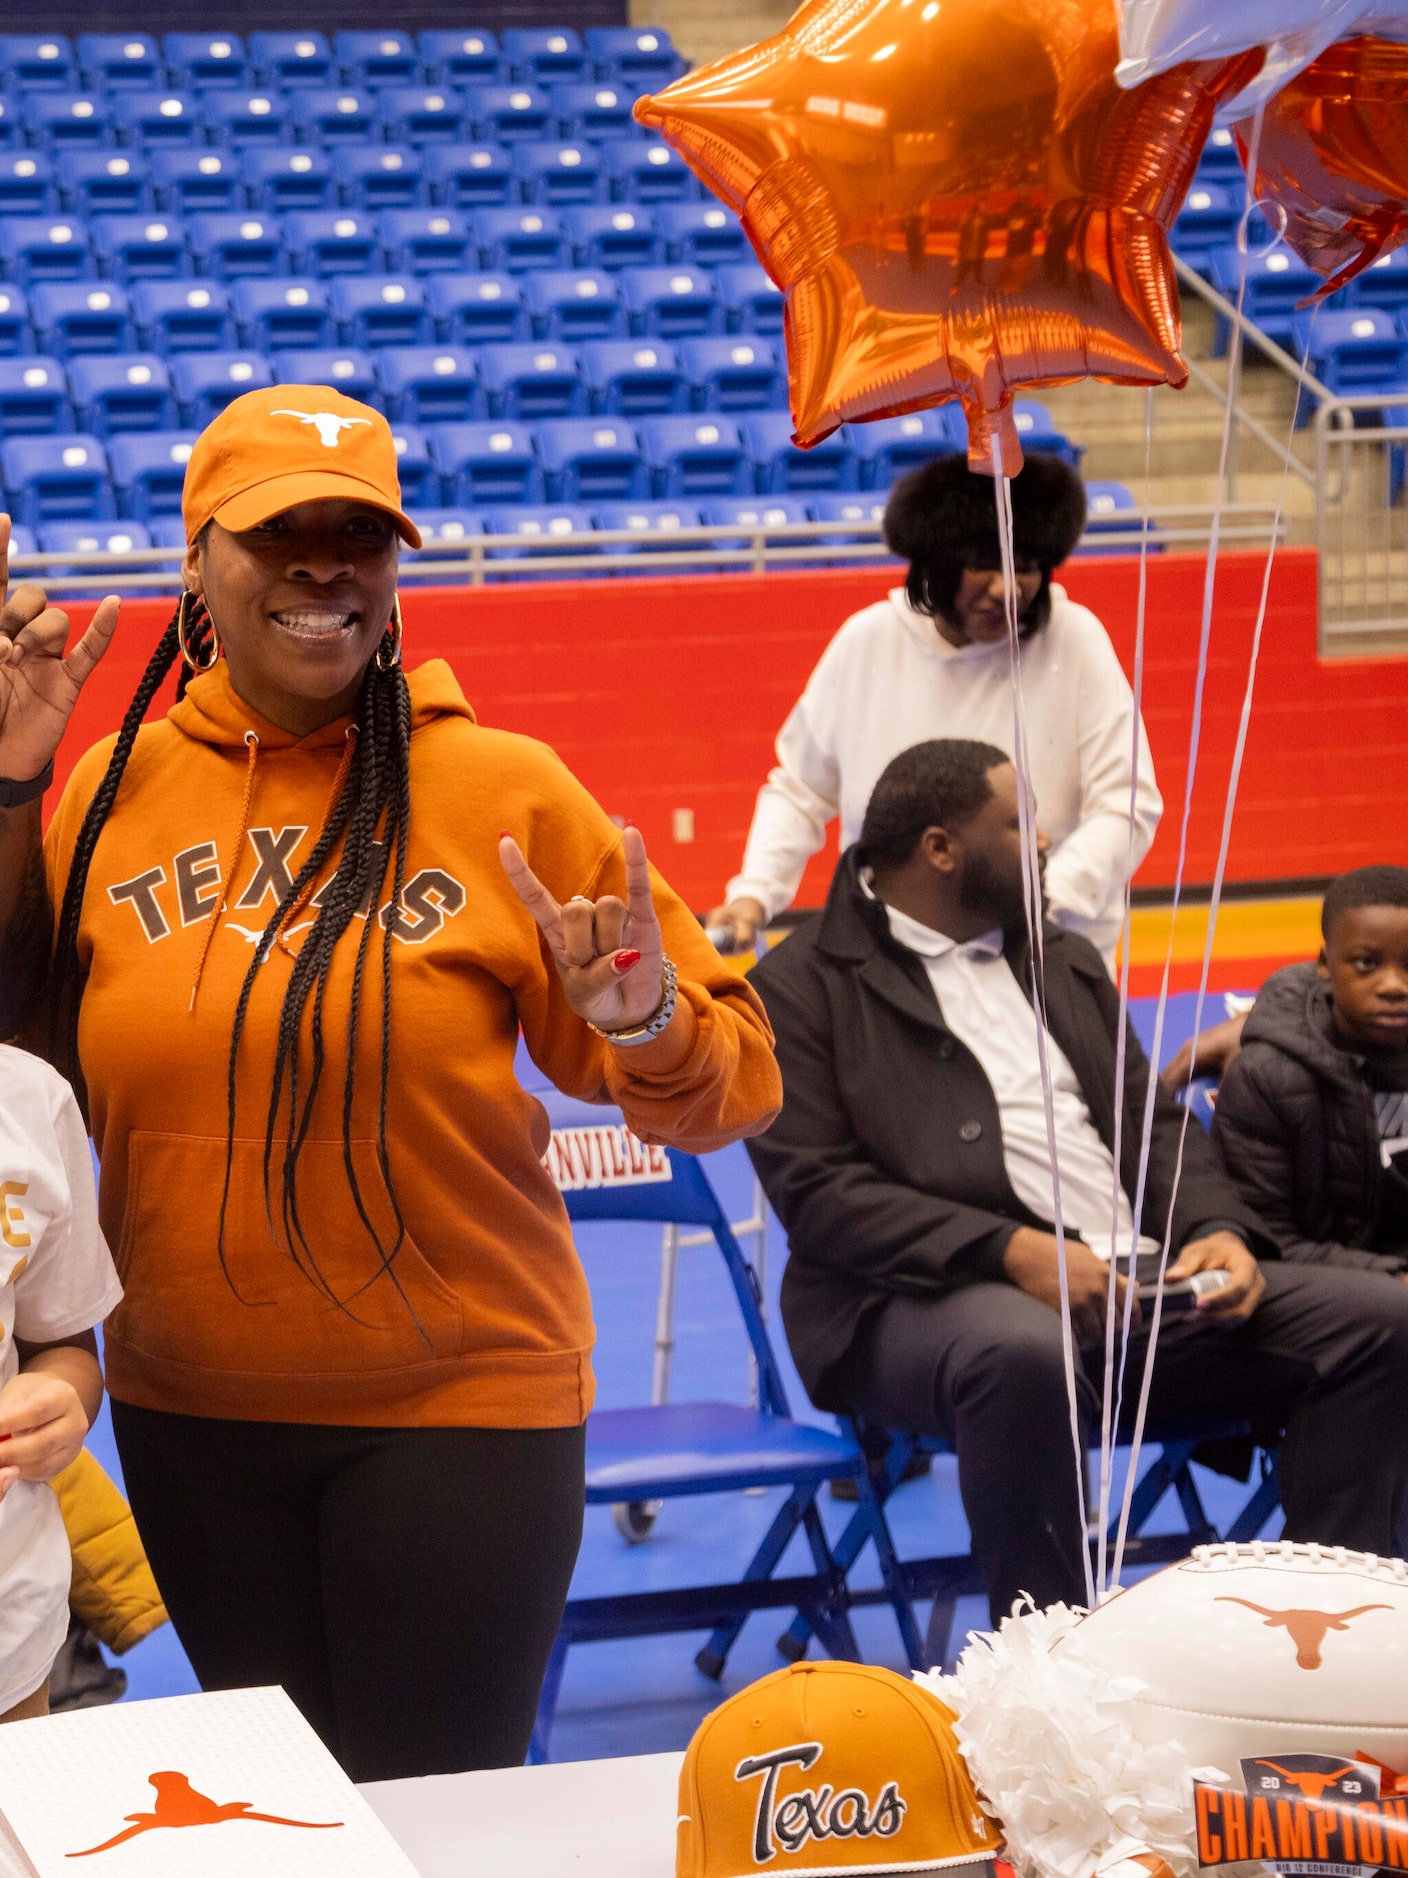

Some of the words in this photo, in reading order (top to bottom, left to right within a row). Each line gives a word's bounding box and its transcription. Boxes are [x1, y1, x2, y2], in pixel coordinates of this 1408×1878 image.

[544, 1126, 671, 1189] NVILLE
[735, 1741, 908, 1865] Texas
[1260, 1776, 1280, 1790] 20
[1342, 1780, 1362, 1794] 23
[1196, 1784, 1408, 1870] CHAMPION
[1276, 1863, 1291, 1873] BIG
[1295, 1863, 1304, 1873] 12
[1307, 1863, 1362, 1876] CONFERENCE
